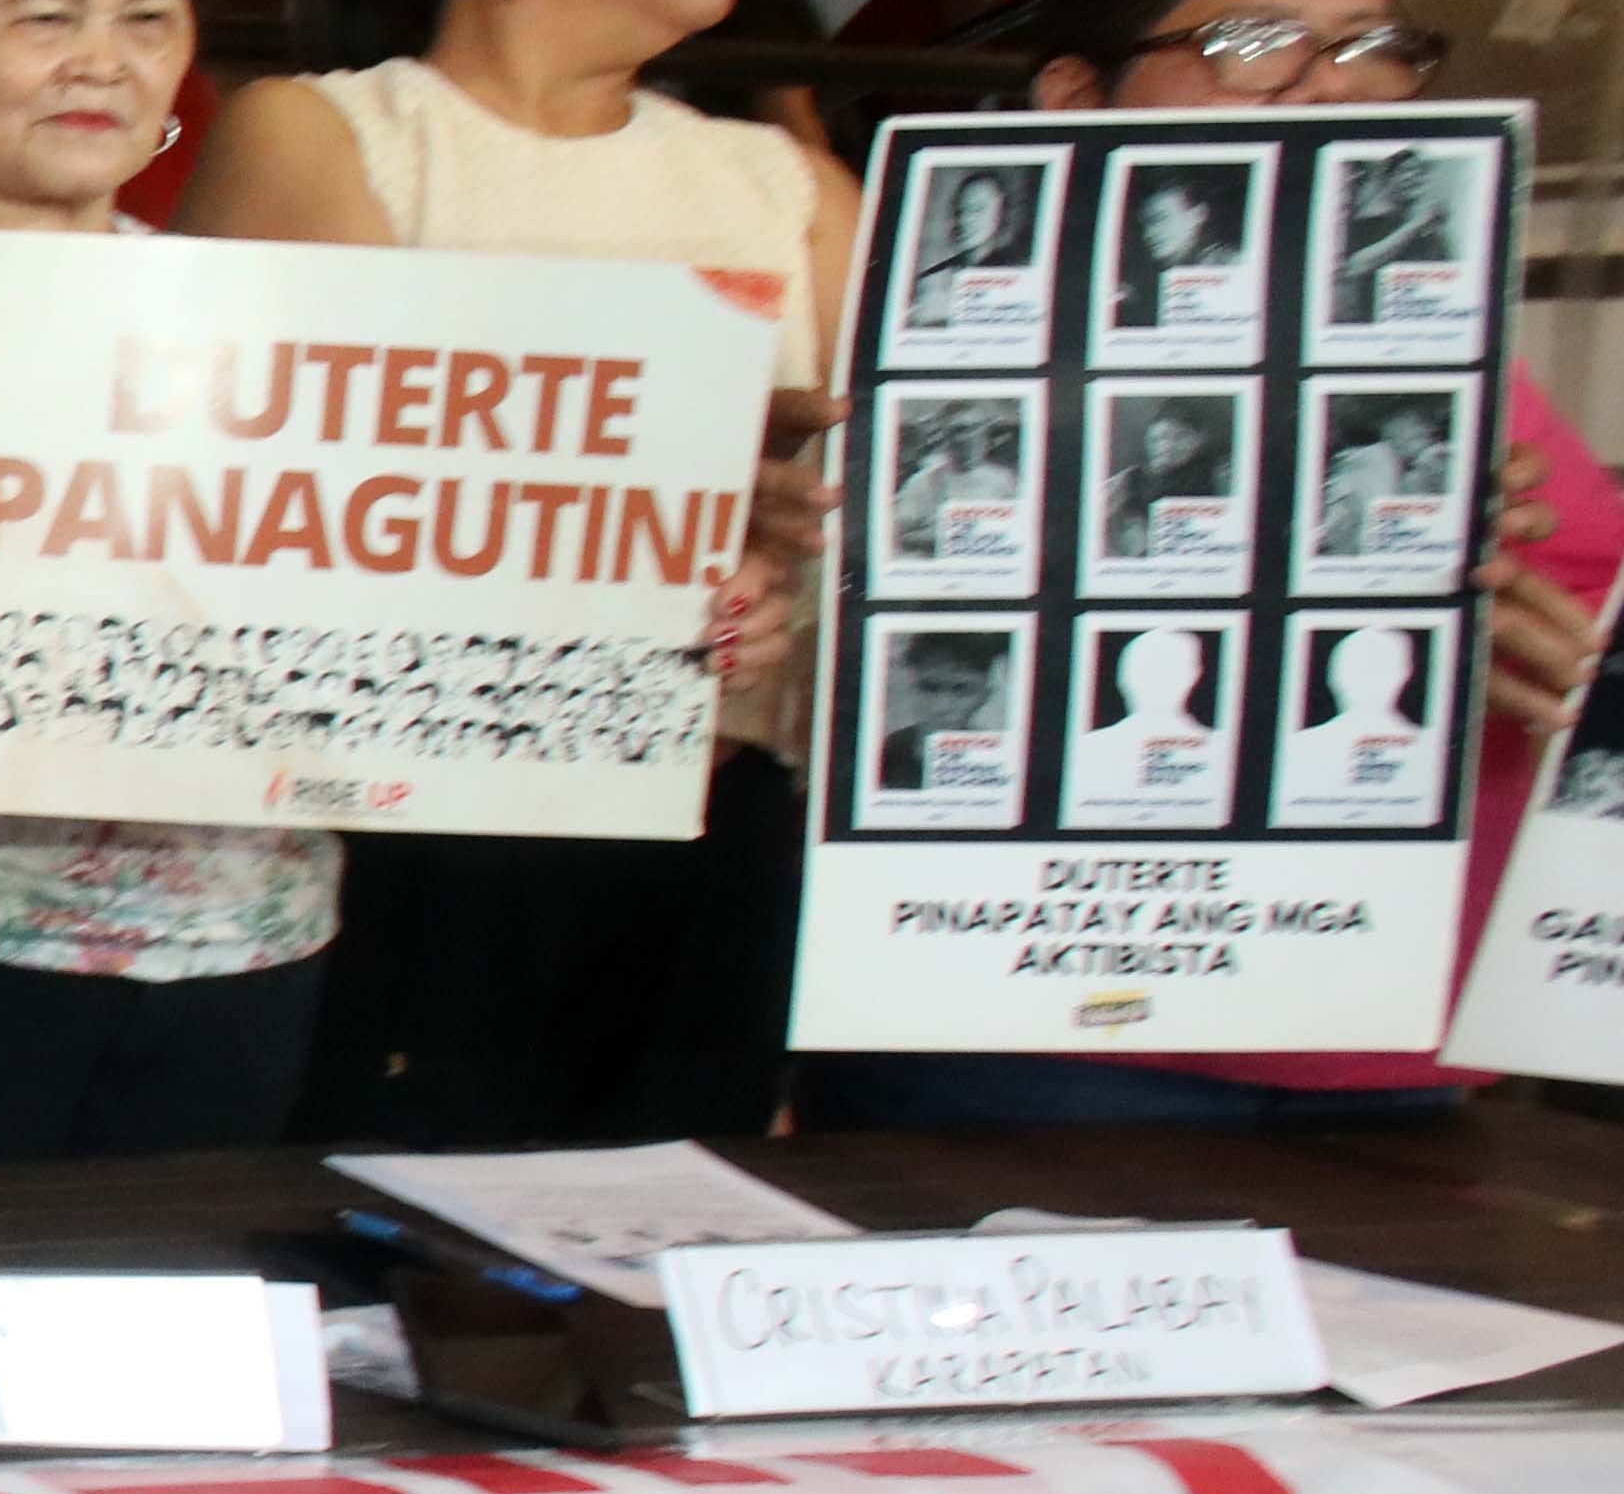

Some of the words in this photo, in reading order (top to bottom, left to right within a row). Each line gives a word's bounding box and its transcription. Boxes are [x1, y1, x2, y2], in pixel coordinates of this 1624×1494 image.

[108, 334, 646, 458] DUTERTE
[1039, 856, 1233, 895] DUTERTE
[889, 898, 1140, 937] PINAPATAY
[1146, 898, 1255, 936] ANG
[1260, 898, 1376, 936] MGA
[1530, 908, 1624, 945] GA
[1008, 941, 1242, 979] AKTIBISTA
[872, 1346, 1154, 1400] KARAPATAN
